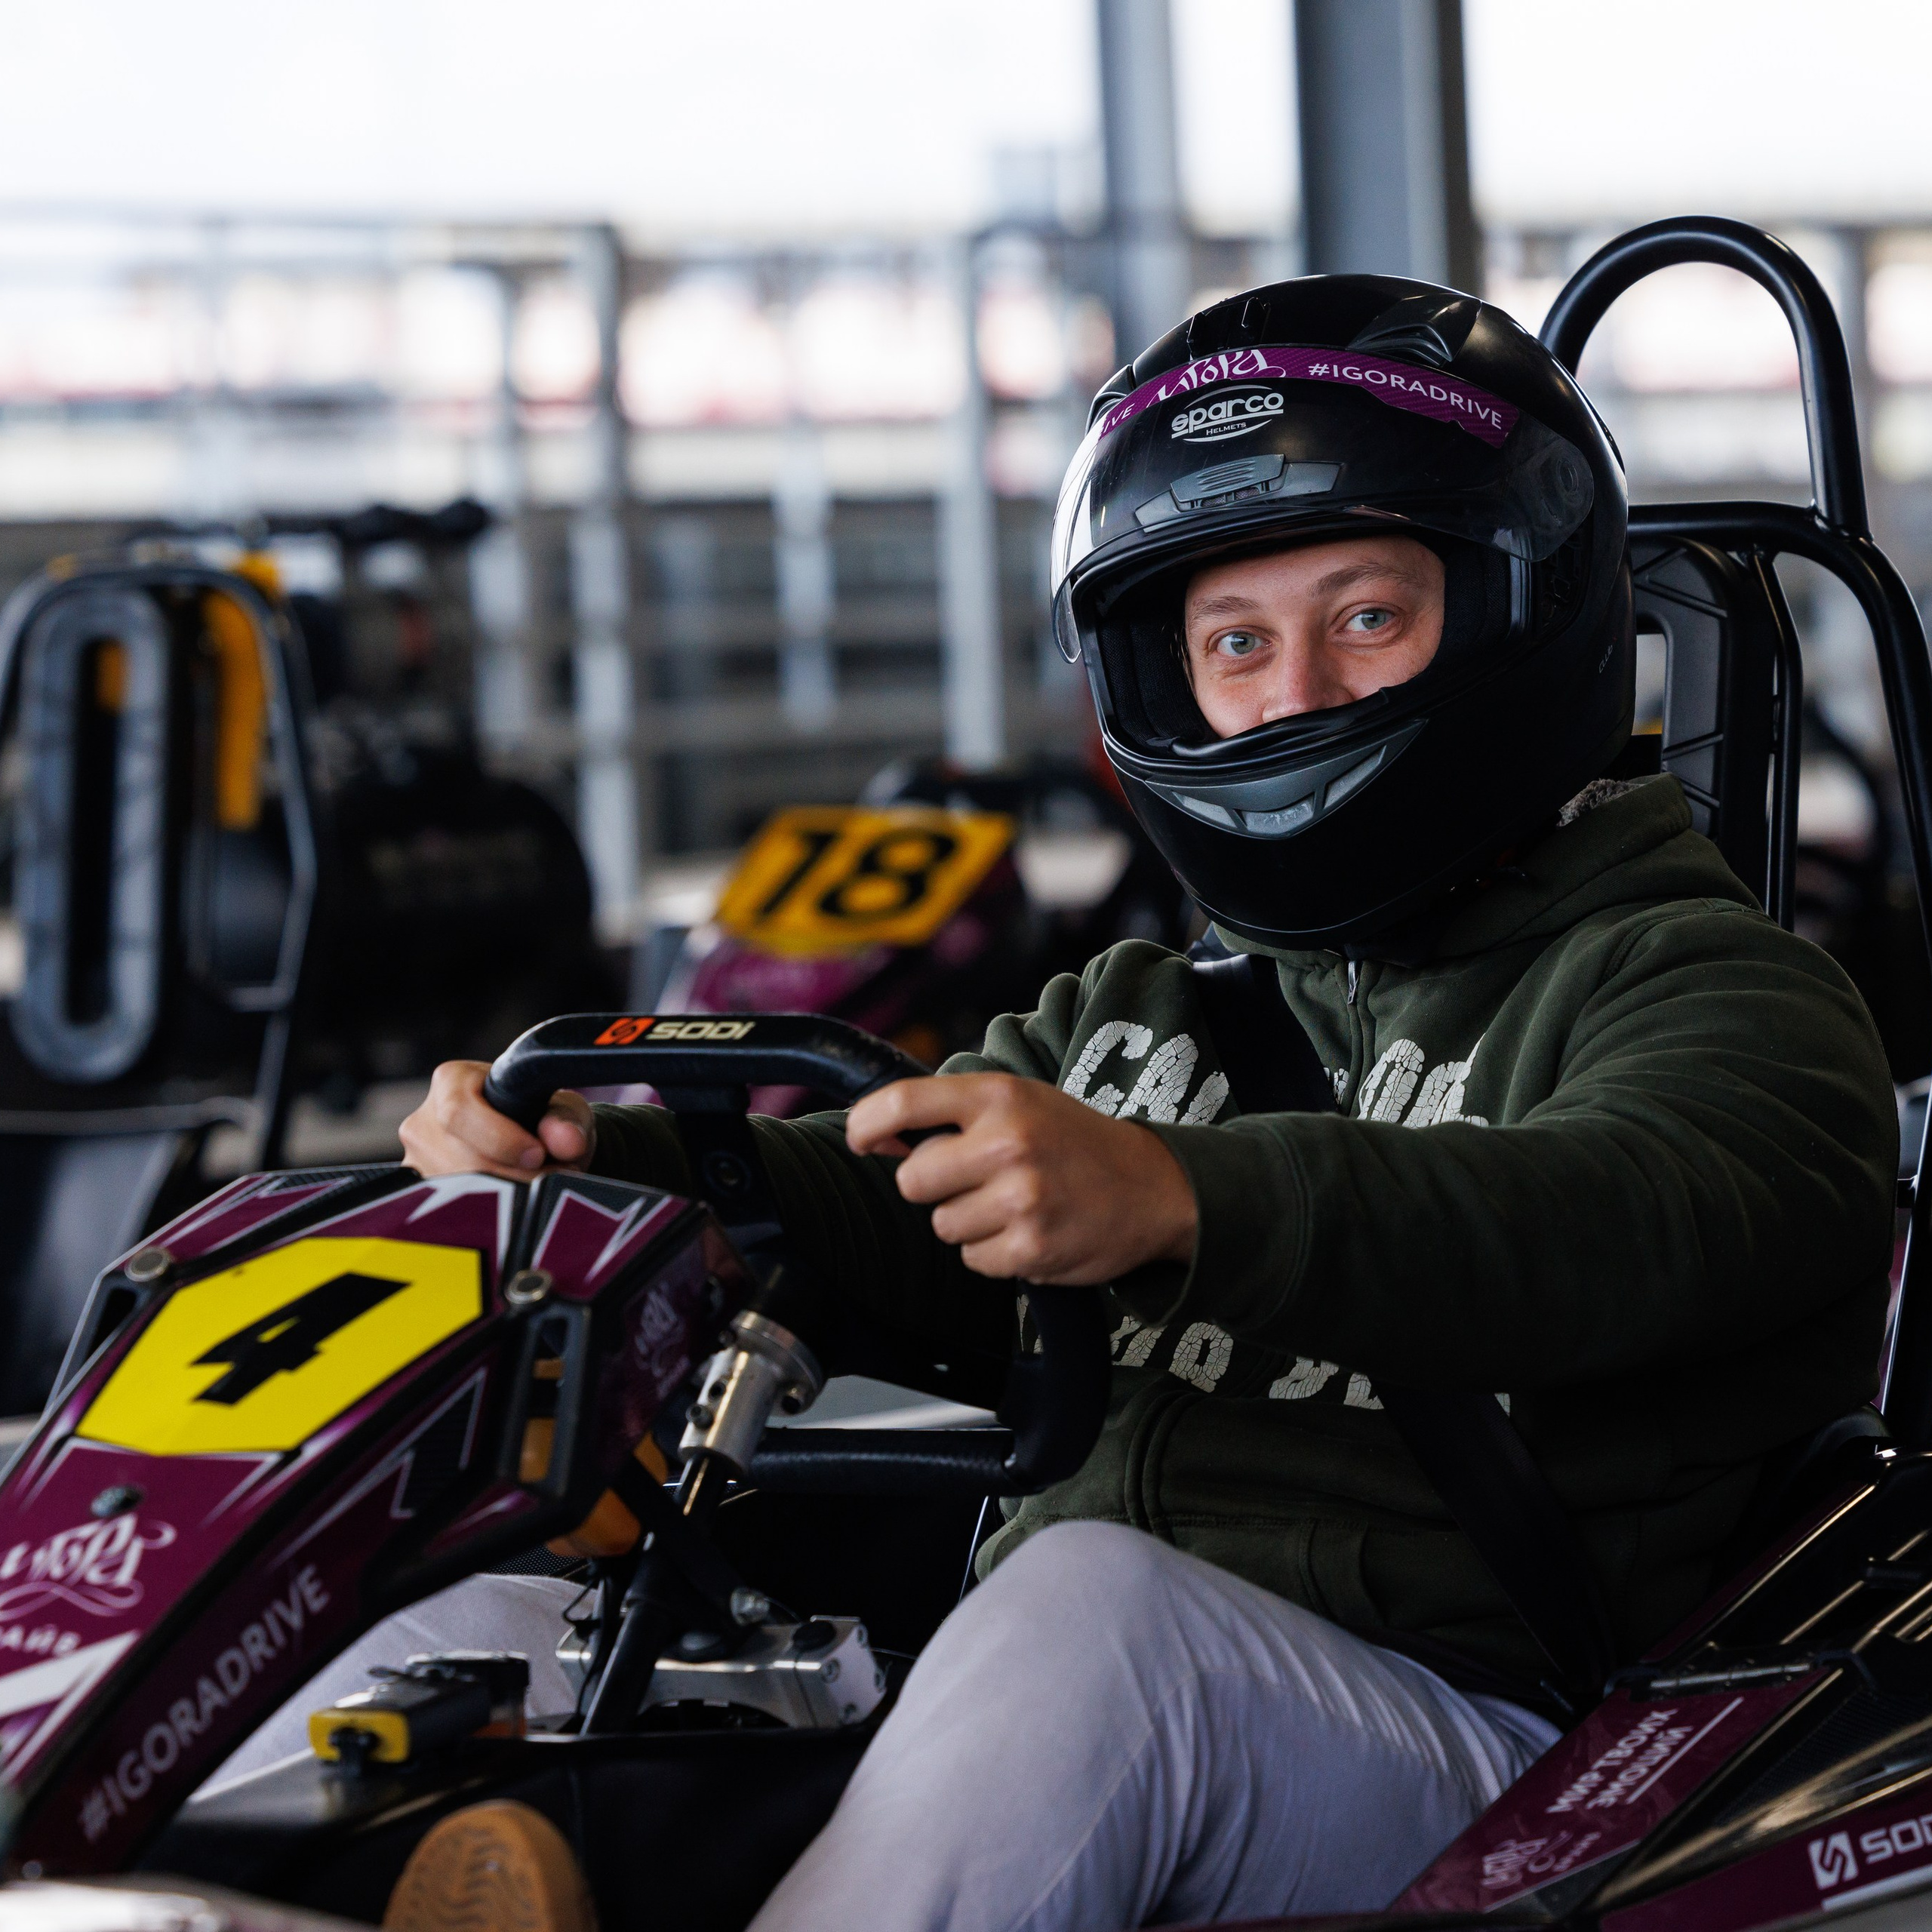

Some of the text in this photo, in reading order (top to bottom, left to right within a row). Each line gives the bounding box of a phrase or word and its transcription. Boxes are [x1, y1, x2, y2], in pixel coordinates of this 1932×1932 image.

[1171, 392, 1284, 434] sparco
[1308, 363, 1502, 430] #IGORADRIVE
[758, 829, 960, 918] 18
[645, 1021, 755, 1040] SODI
[190, 1272, 412, 1405] 4
[77, 1564, 332, 1844] #IGORADRIVE
